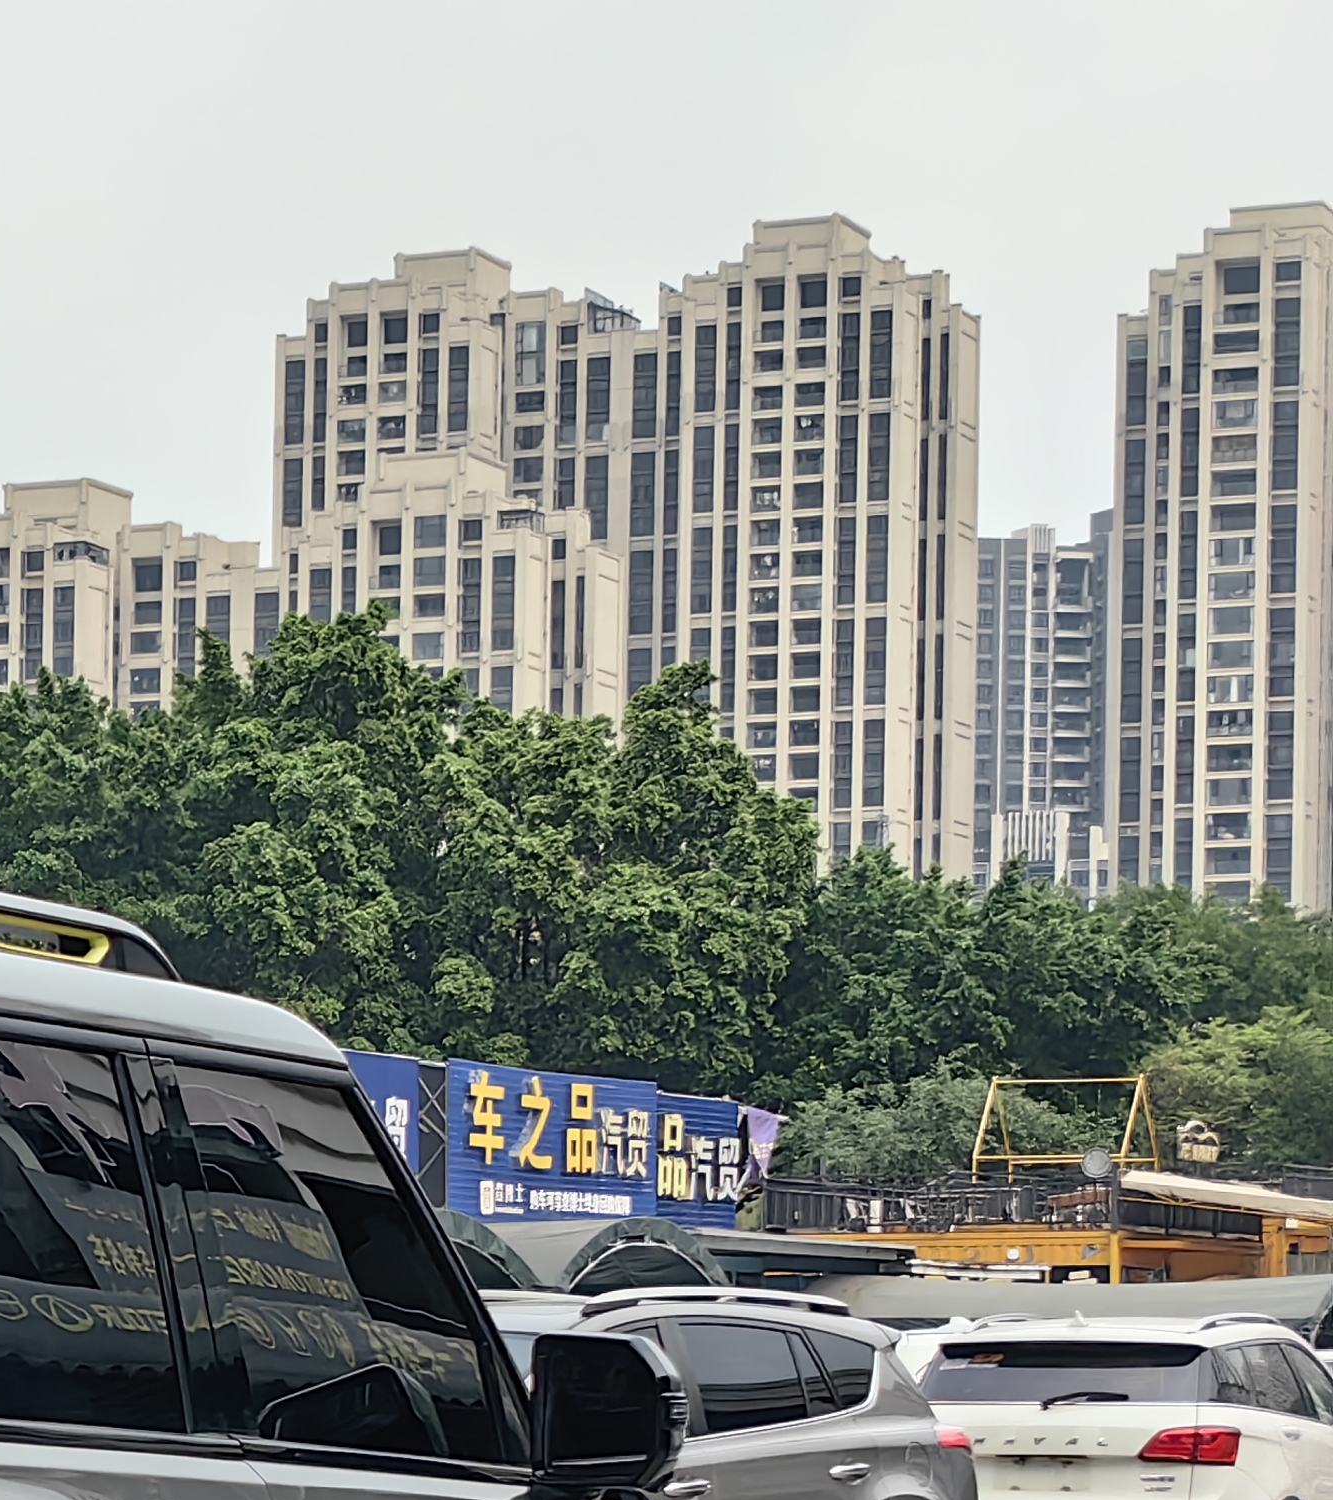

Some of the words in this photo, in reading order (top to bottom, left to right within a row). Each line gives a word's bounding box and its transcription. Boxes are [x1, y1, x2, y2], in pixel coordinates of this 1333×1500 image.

[469, 1071, 650, 1179] 车之品汽贸
